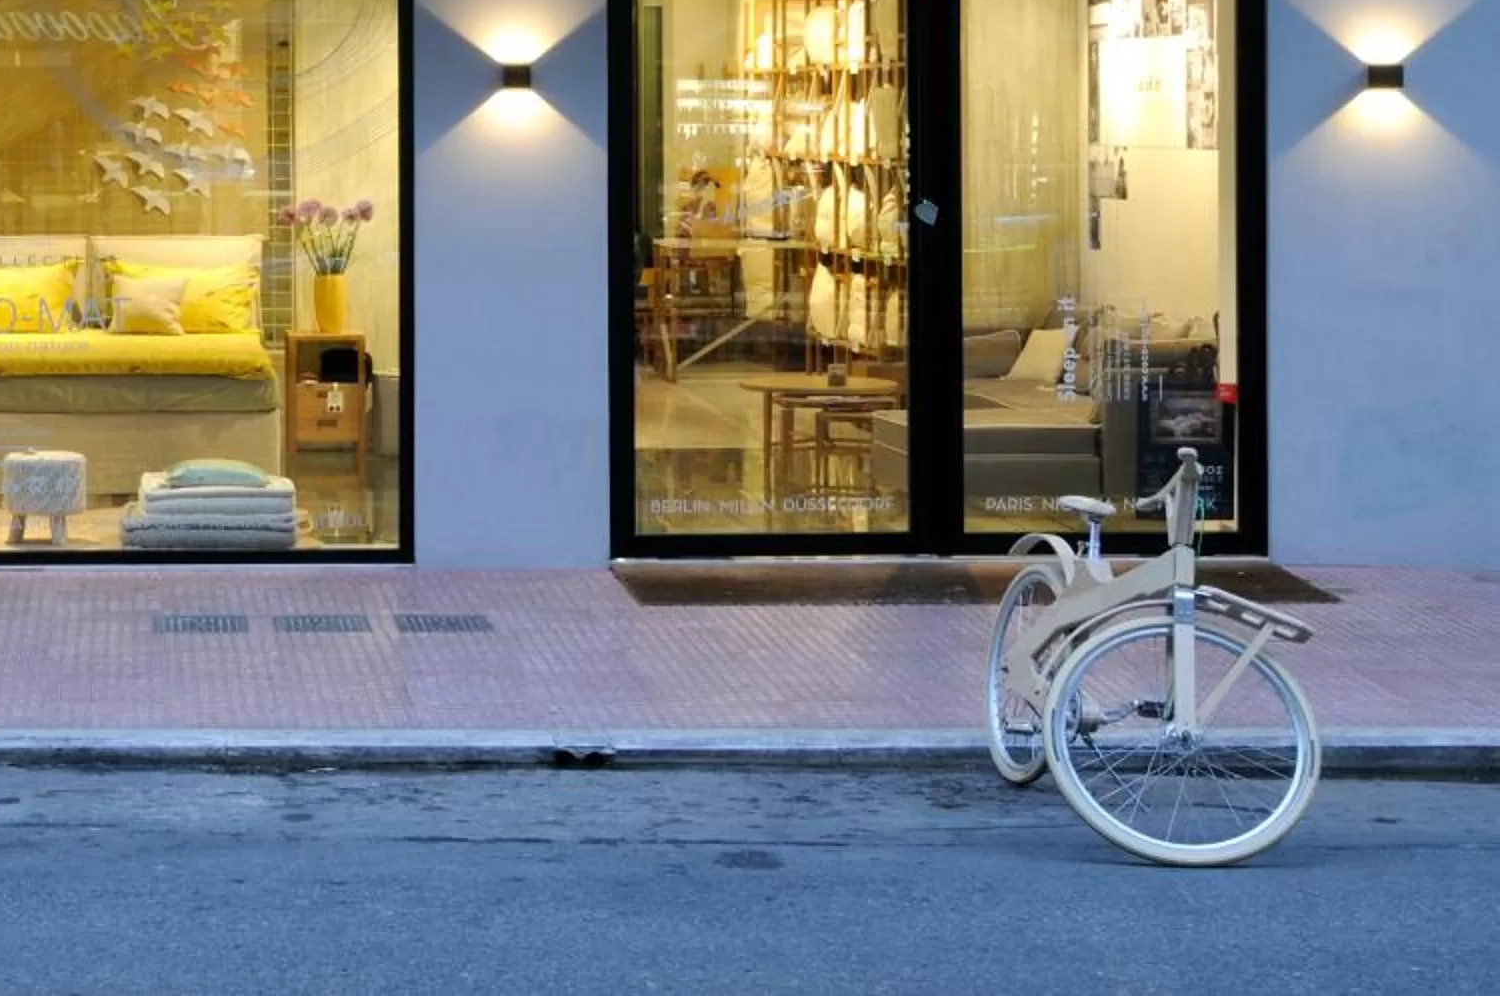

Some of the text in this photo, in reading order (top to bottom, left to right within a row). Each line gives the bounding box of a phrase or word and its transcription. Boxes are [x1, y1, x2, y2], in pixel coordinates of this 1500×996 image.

[650, 499, 711, 514] BERLIN
[719, 498, 775, 513] MILN
[985, 496, 1033, 511] PARIS
